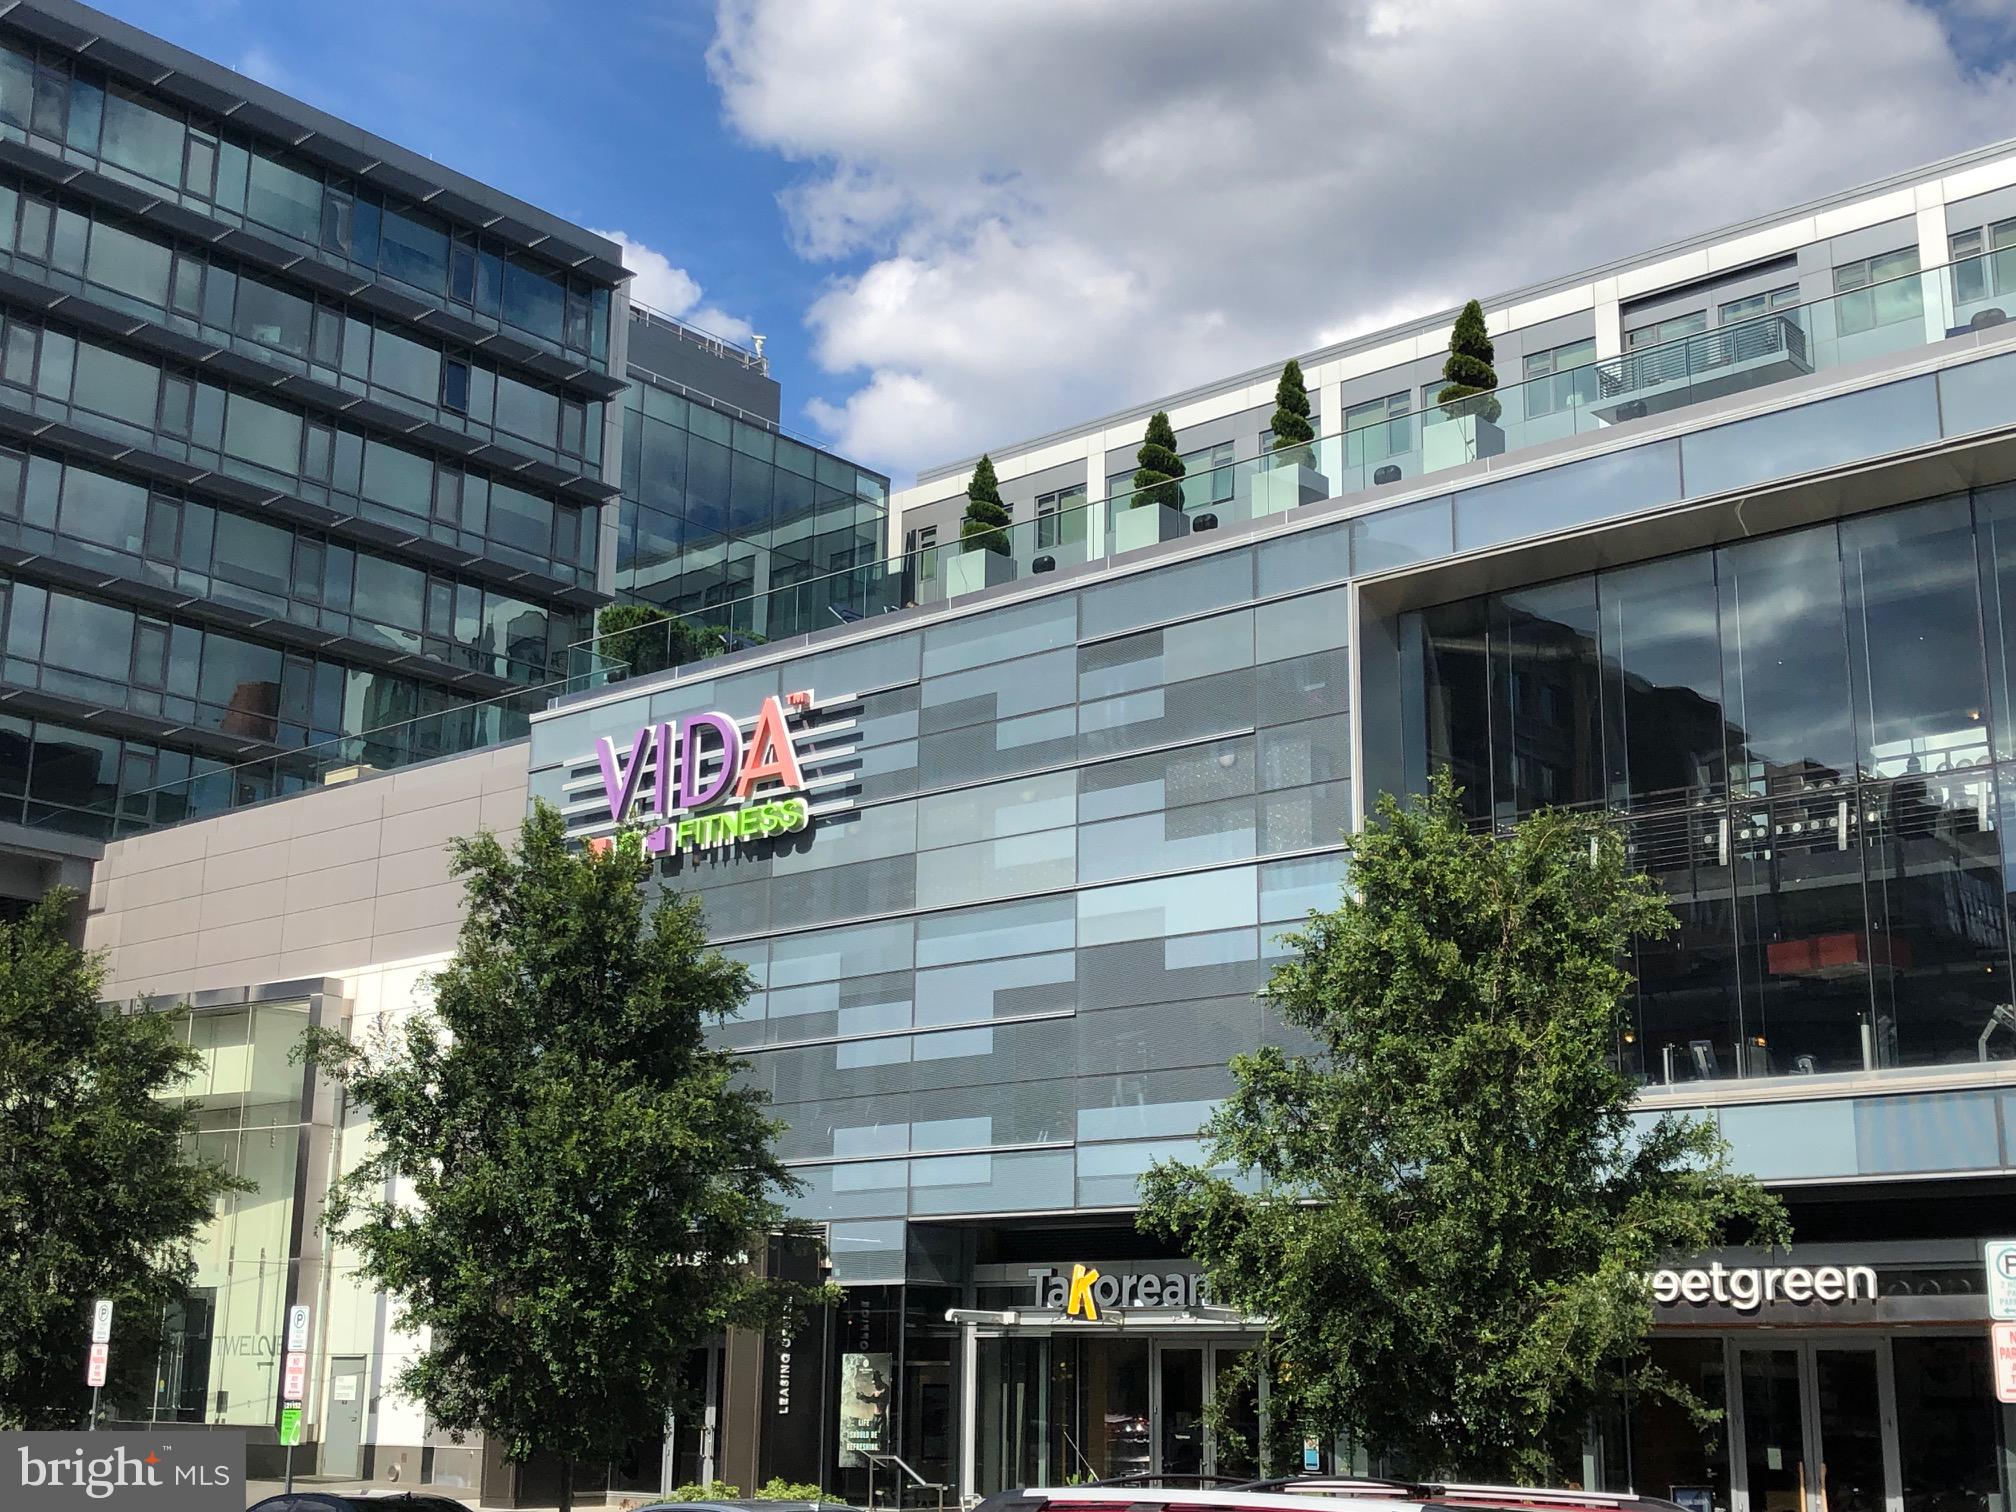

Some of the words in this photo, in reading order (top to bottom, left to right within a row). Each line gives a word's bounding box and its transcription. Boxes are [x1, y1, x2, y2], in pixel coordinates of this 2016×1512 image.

[596, 695, 803, 822] VIDA
[678, 798, 808, 852] FITNESS
[1645, 1262, 1878, 1310] eetgreen
[779, 1353, 791, 1415] LEASING
